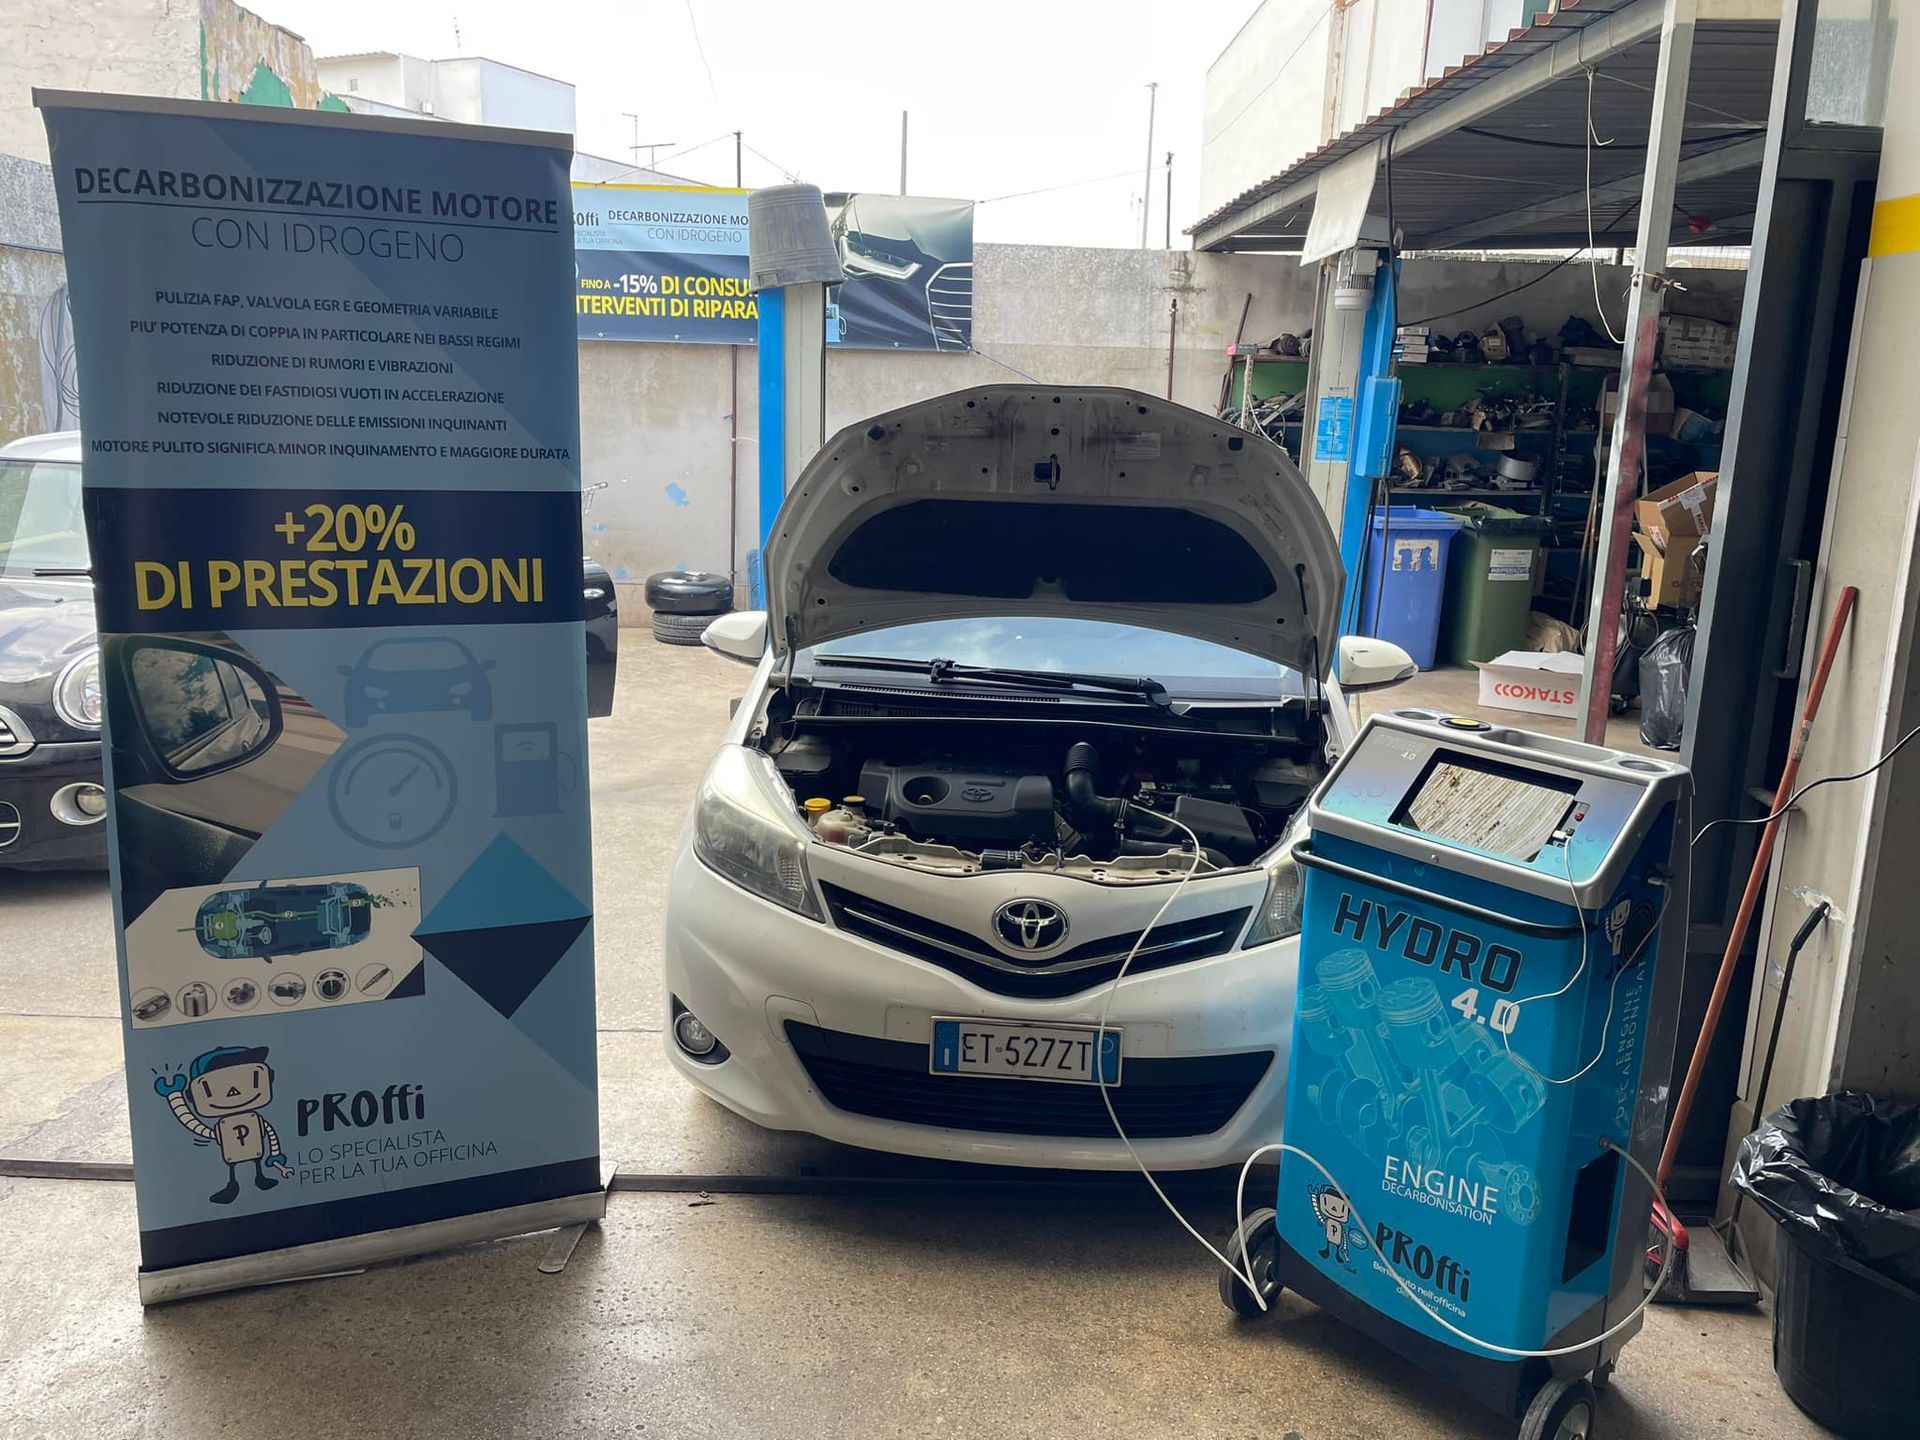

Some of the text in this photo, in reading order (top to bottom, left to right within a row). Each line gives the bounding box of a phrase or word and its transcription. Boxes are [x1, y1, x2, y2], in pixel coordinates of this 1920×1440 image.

[75, 168, 558, 224] DECARBONIZZAZIONE MOTORE
[574, 211, 599, 227] Offi
[608, 210, 749, 226] DECARBONIZZAZIONE MO
[191, 216, 464, 262] CON IDROGENO
[647, 227, 742, 243] CON IDROGENO
[581, 274, 758, 297] FINO A -15% DI CONSU
[155, 291, 211, 306] PULIZIA
[246, 295, 311, 310] VALVOLA
[314, 299, 342, 312] EGR
[343, 300, 351, 312] E
[353, 300, 431, 316] GEOMETRIA
[433, 305, 499, 320] VARIABILE
[670, 298, 689, 317] DI
[693, 299, 759, 319] RIPARA
[160, 322, 228, 336] POTENZA
[231, 325, 245, 337] DI
[249, 325, 300, 339] COPPIA
[303, 328, 318, 340] IN
[321, 329, 411, 344] PARTICOLARE
[414, 334, 436, 345] NEI
[439, 335, 474, 348] BASSI
[476, 336, 521, 349] REGIMI
[211, 354, 453, 374] RIDUZIONE DI RUMORI E VIBRAZIONI
[157, 381, 505, 404] RIDUZIONE DEI FASTIDIOSI VUOTI IN ACCELERAZIONE
[158, 411, 507, 432] NOTEVOLE RIDUZIONE DELLE EMISSIONI INQUINANTI
[91, 440, 570, 460] MOTORE PULITO SIGNIFICA MINOR INQUINAMENTO E MAGGIORE DURATA
[274, 504, 415, 552] +20%
[134, 557, 544, 611] DI PRESTAZIONI
[1332, 892, 1524, 994] HYDRO
[1451, 987, 1521, 1035] 4.0
[298, 1129, 446, 1166] LO SPECIALISTA
[300, 1140, 498, 1185] PER LA TUA OFFICINA
[1384, 1155, 1500, 1215] ENGINE
[1381, 1179, 1493, 1226] DECARBONISATION
